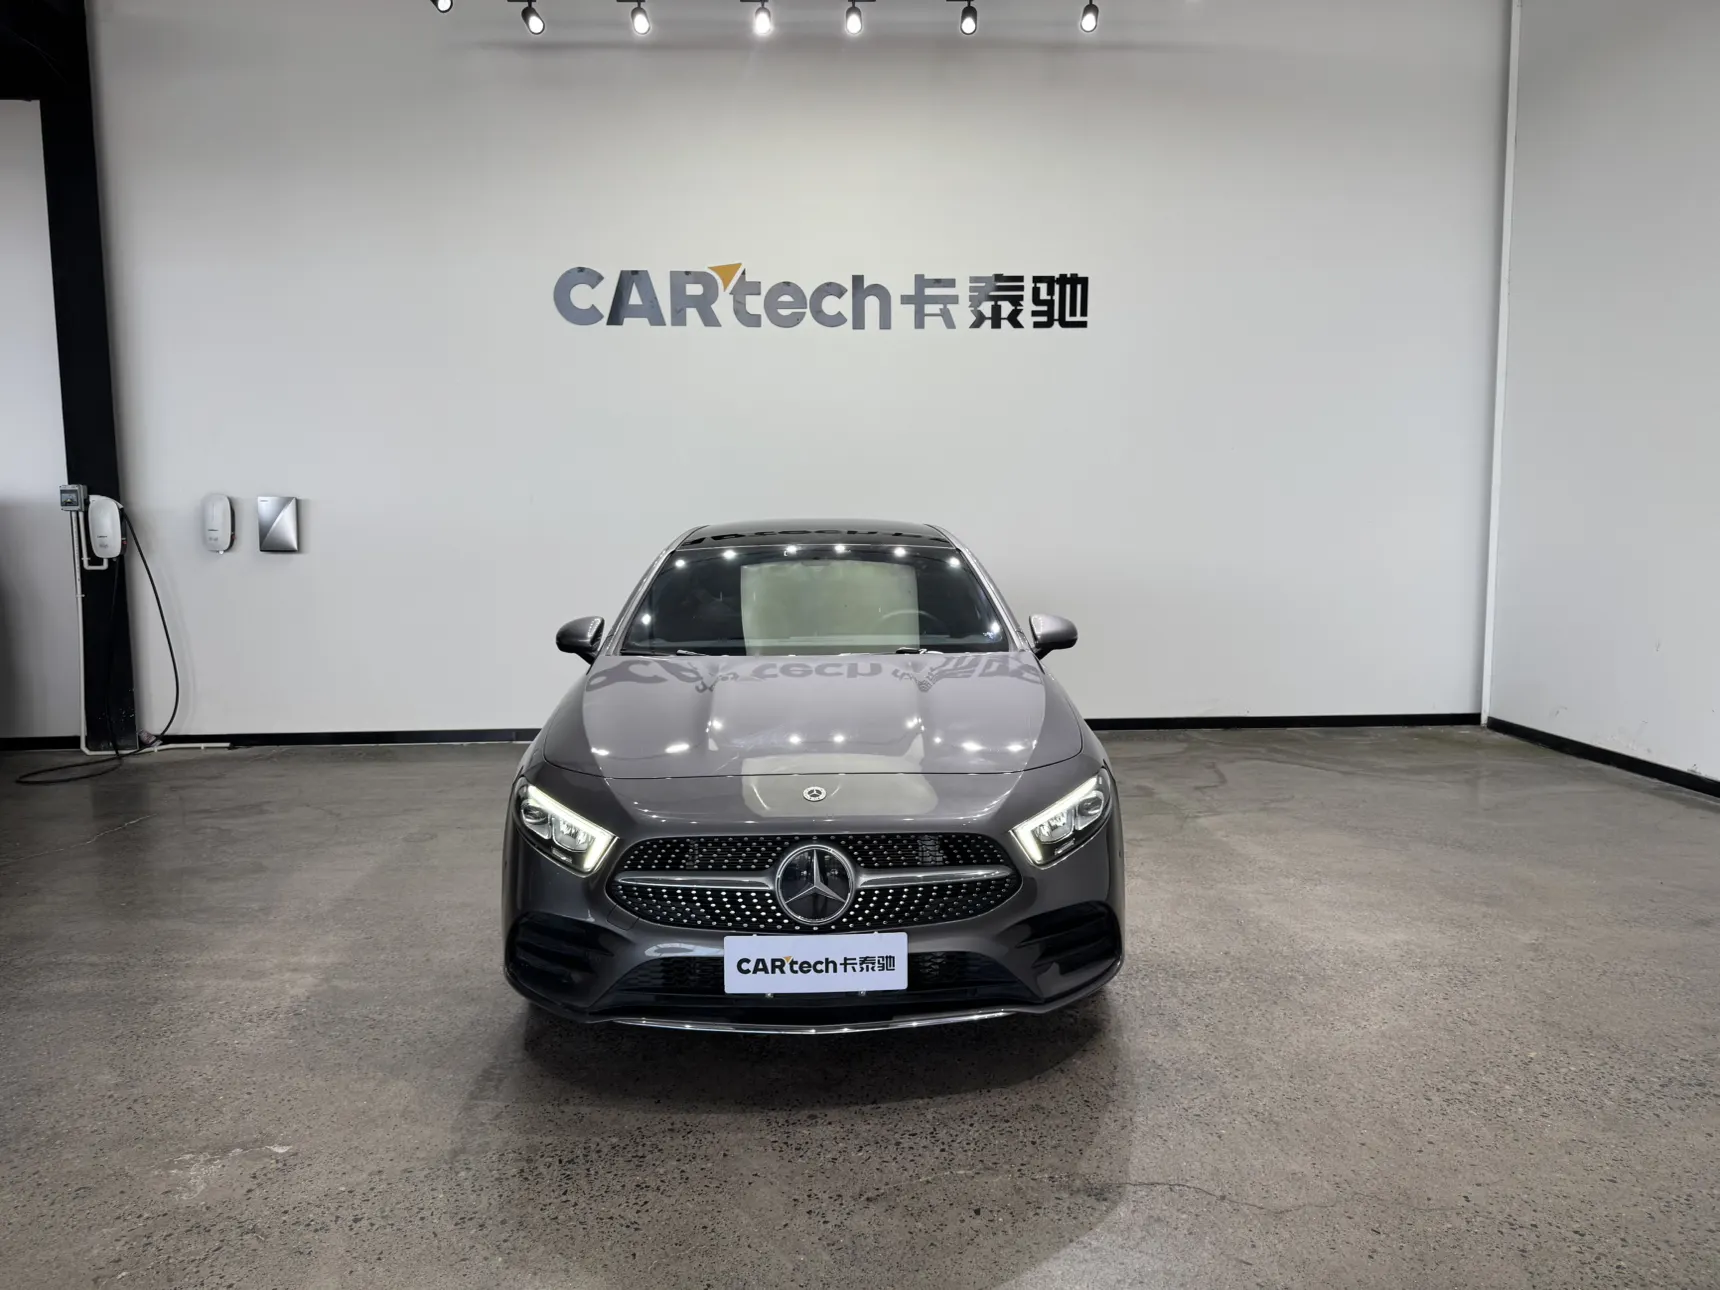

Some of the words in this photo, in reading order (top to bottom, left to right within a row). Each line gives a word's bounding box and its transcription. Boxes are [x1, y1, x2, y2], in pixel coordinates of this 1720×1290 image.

[553, 263, 892, 330] CARtech
[901, 272, 1089, 330] 卡泰驰
[736, 956, 838, 975] CARtech
[839, 954, 896, 973] 卡泰驰
